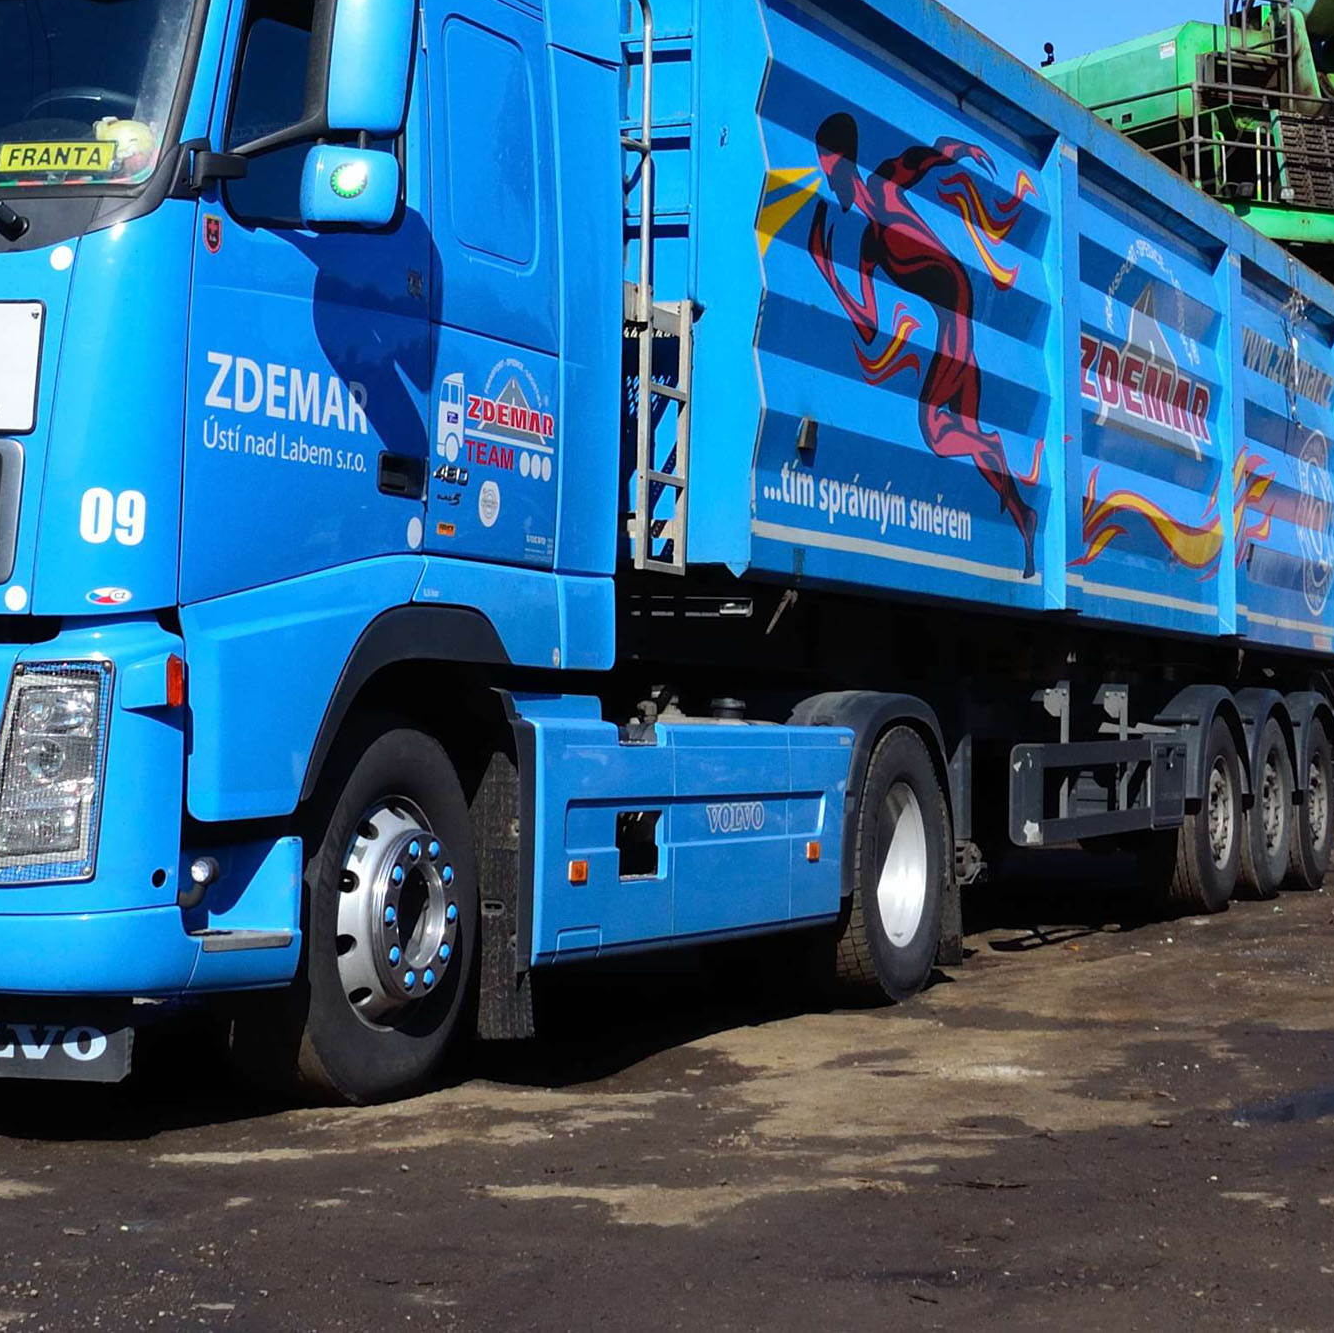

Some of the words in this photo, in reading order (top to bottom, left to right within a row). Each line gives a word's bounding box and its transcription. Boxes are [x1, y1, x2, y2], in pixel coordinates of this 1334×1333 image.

[8, 146, 102, 167] FRANTA
[204, 351, 368, 434] ZDEMAR
[467, 394, 555, 439] ZDEMAR
[1079, 331, 1212, 446] ZDEMAR
[203, 415, 242, 452] Ústí
[244, 430, 278, 459] nad
[280, 433, 333, 467] Labem
[336, 449, 367, 473] s.r.o.
[465, 439, 515, 471] TEAM
[79, 486, 147, 546] 09
[818, 473, 906, 535] správným
[909, 493, 972, 542] směrem
[706, 801, 765, 834] VOLVO
